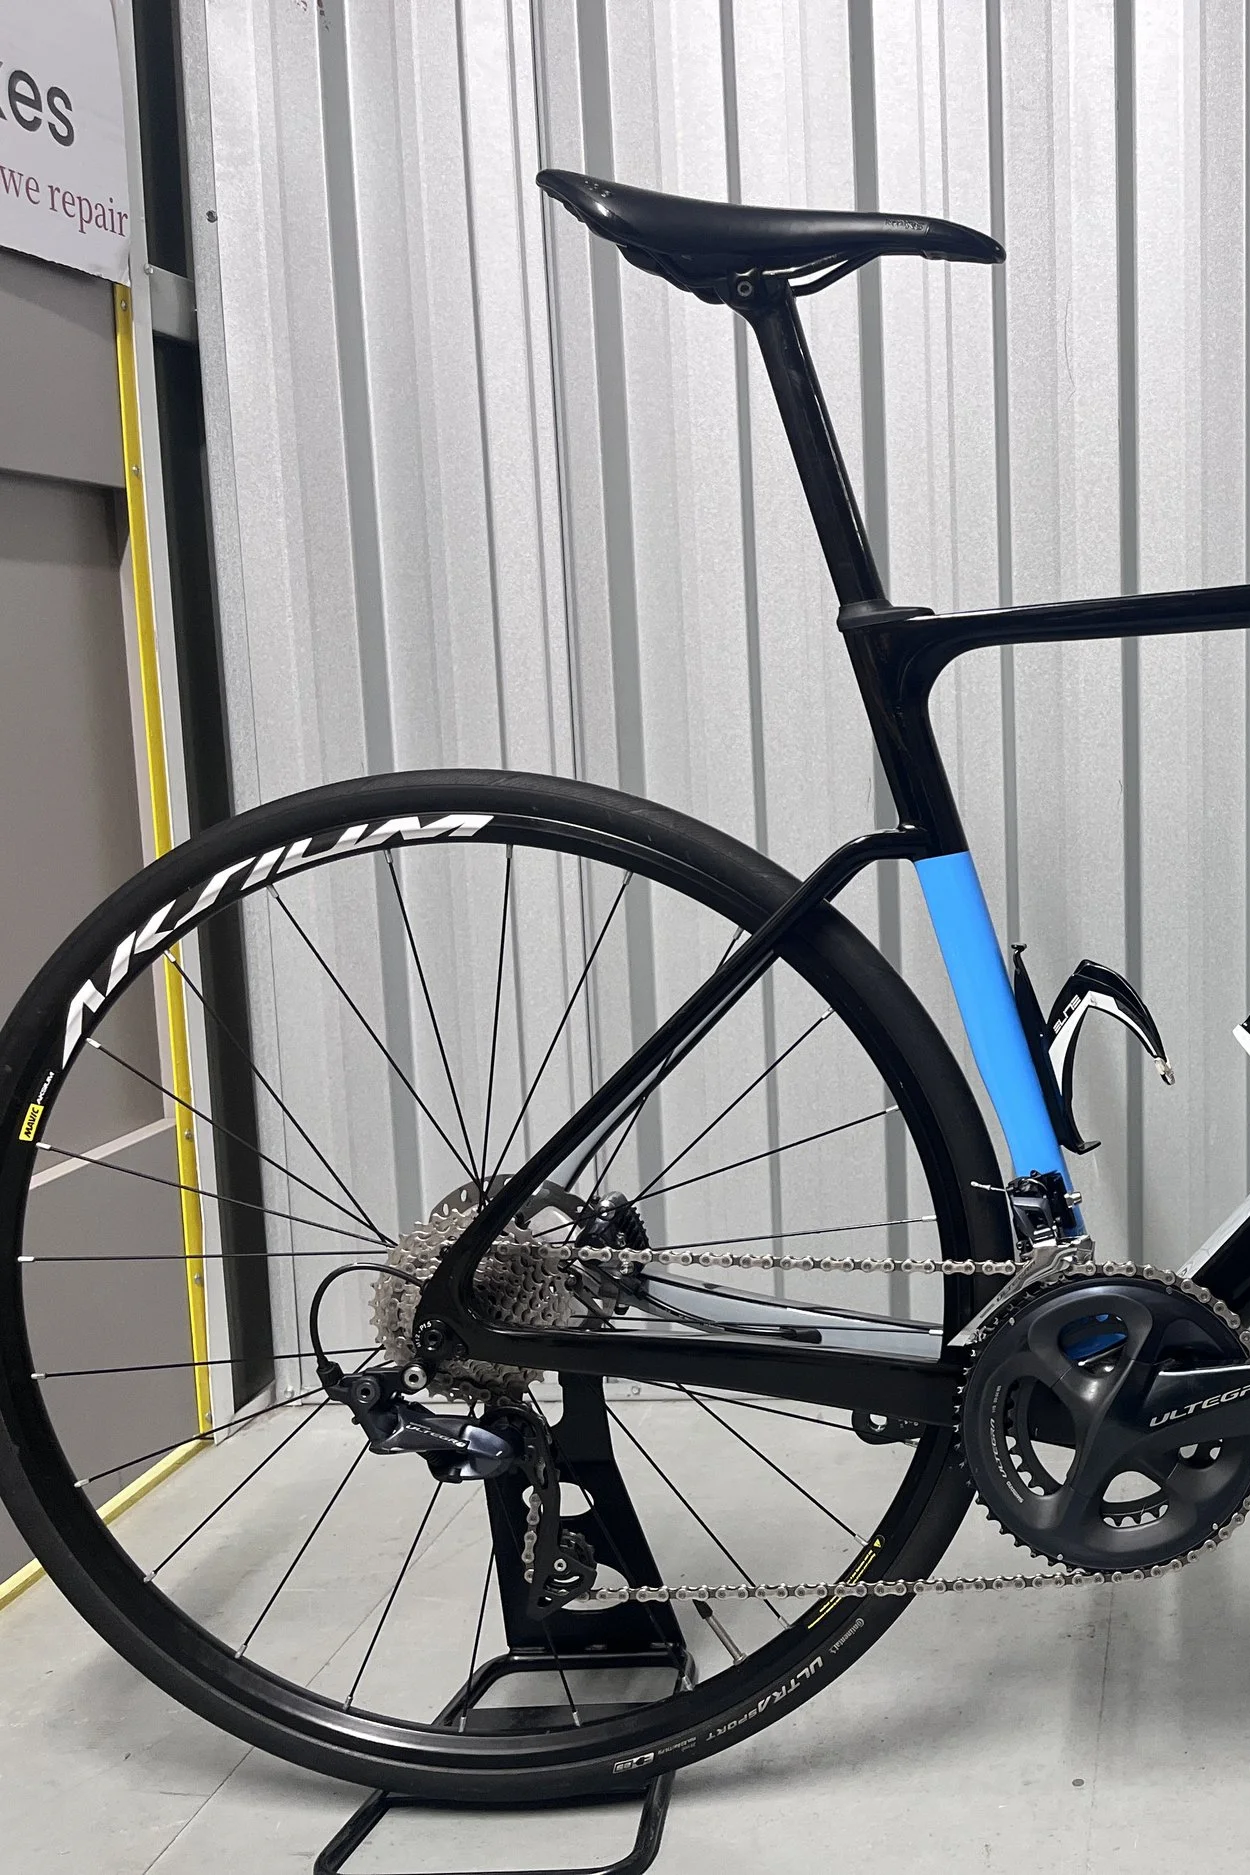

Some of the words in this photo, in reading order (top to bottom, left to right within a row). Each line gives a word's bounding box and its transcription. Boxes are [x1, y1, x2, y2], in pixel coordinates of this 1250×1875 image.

[0, 61, 75, 147] es
[0, 166, 41, 205] we
[48, 185, 129, 237] repair
[24, 1106, 40, 1139] MAVIC
[990, 1418, 1008, 1478] ULTEGRA
[832, 1618, 865, 1653] Continental
